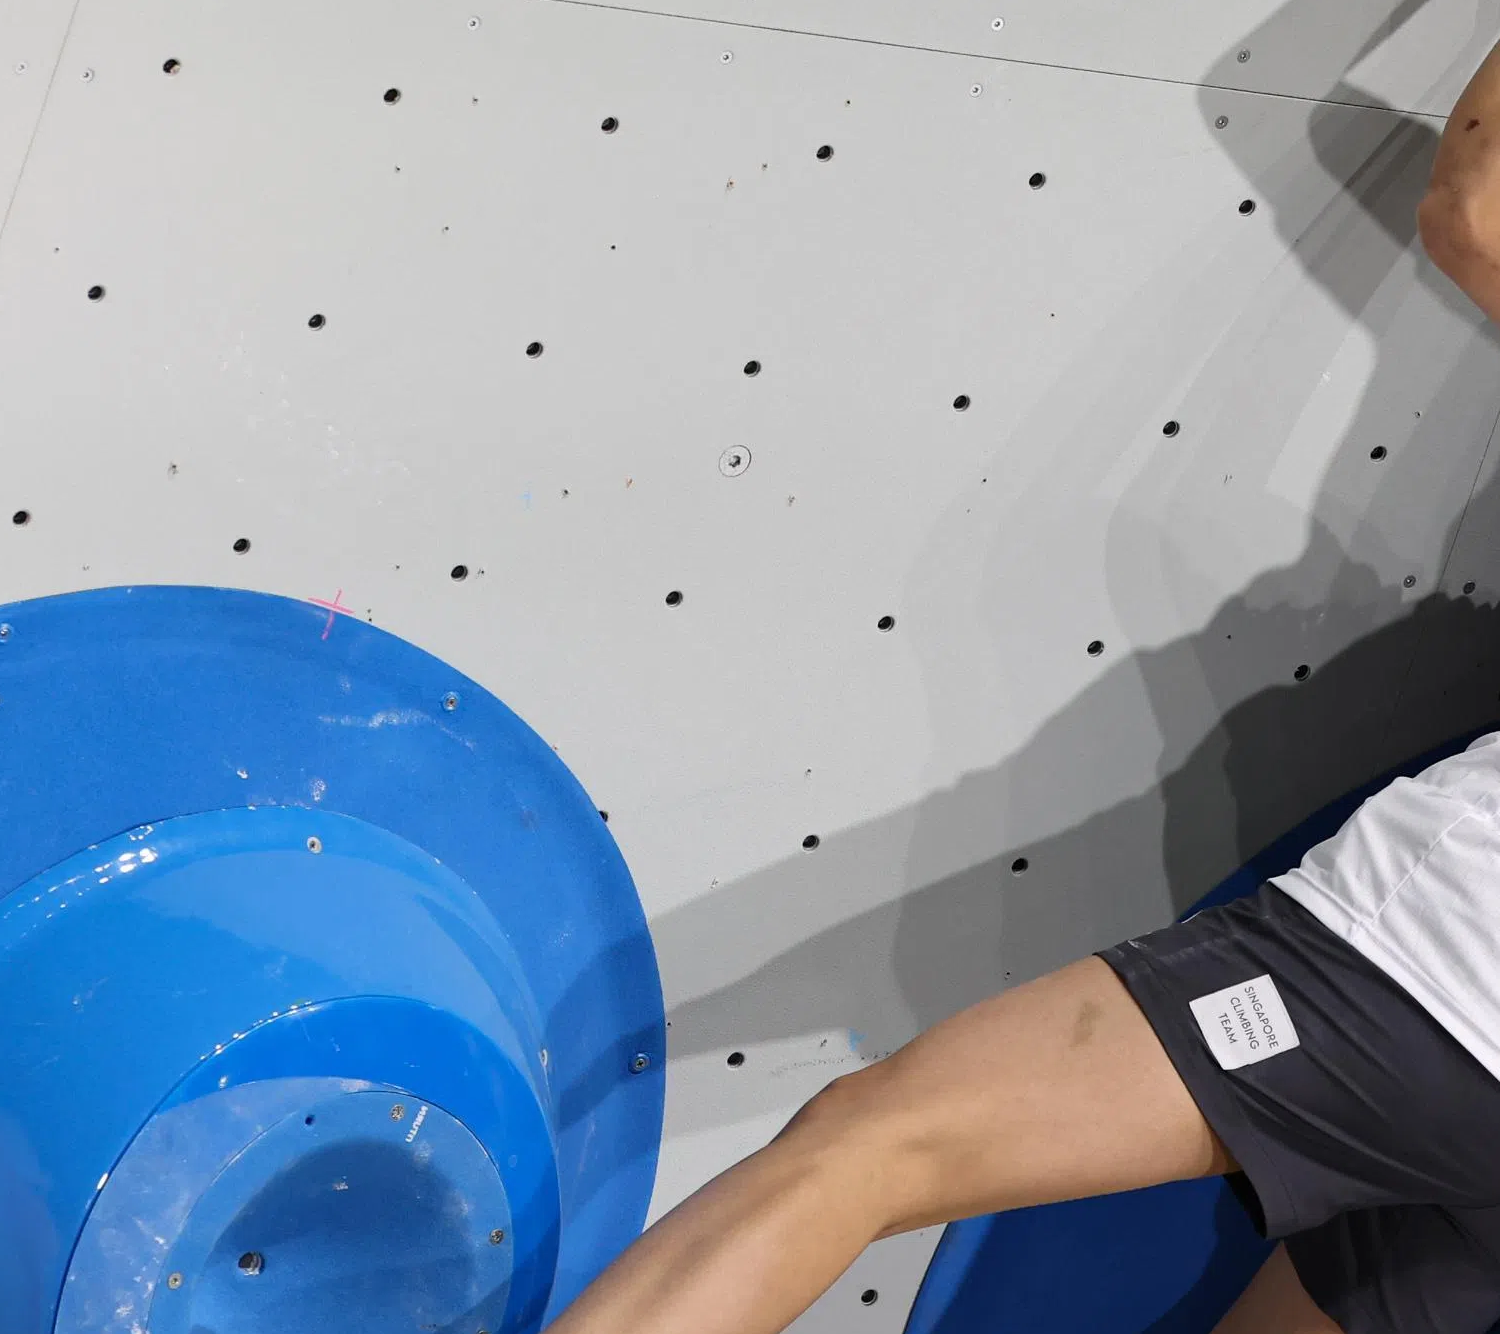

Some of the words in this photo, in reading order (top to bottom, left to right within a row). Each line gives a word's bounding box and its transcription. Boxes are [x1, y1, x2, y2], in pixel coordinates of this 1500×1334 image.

[1218, 1012, 1238, 1044] TEAM
[1230, 996, 1260, 1050] CLIMBING
[1244, 986, 1279, 1049] SINGAPORE
